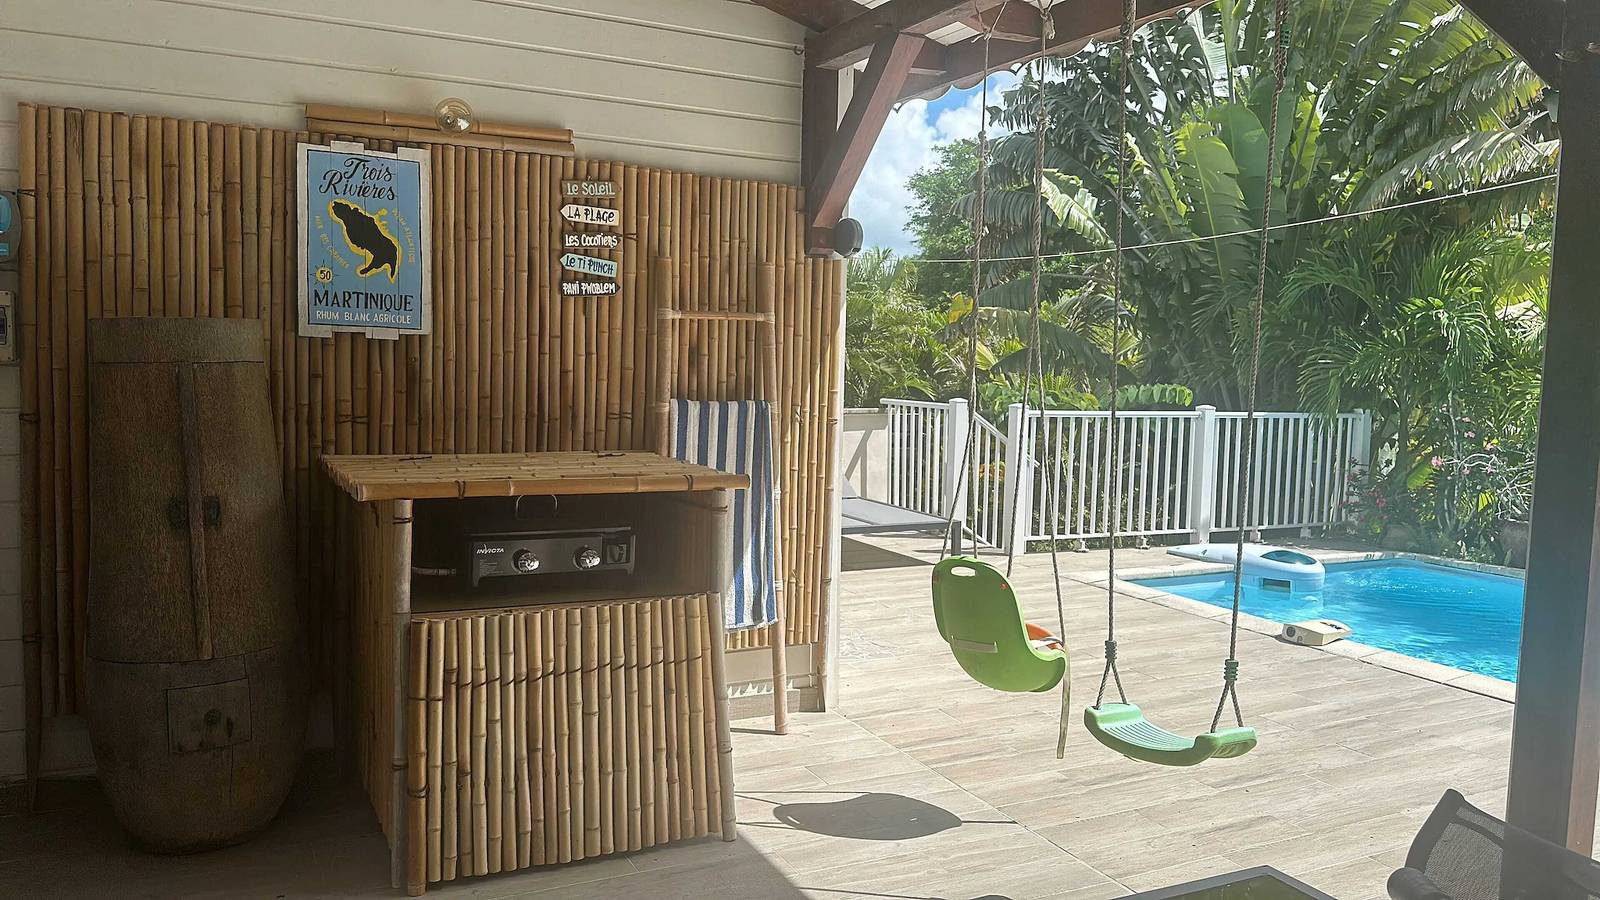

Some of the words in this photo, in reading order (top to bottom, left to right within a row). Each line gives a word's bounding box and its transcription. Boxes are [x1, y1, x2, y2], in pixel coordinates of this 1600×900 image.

[343, 157, 393, 182] Trois
[567, 206, 581, 219] LA
[320, 269, 331, 280] 50
[587, 259, 614, 275] PUNCH
[313, 289, 414, 312] MARTINIQUE
[316, 310, 339, 321] RHUM
[344, 311, 371, 322] BLANC
[373, 312, 411, 325] AGRICOLE
[476, 544, 505, 554] INVICTA
